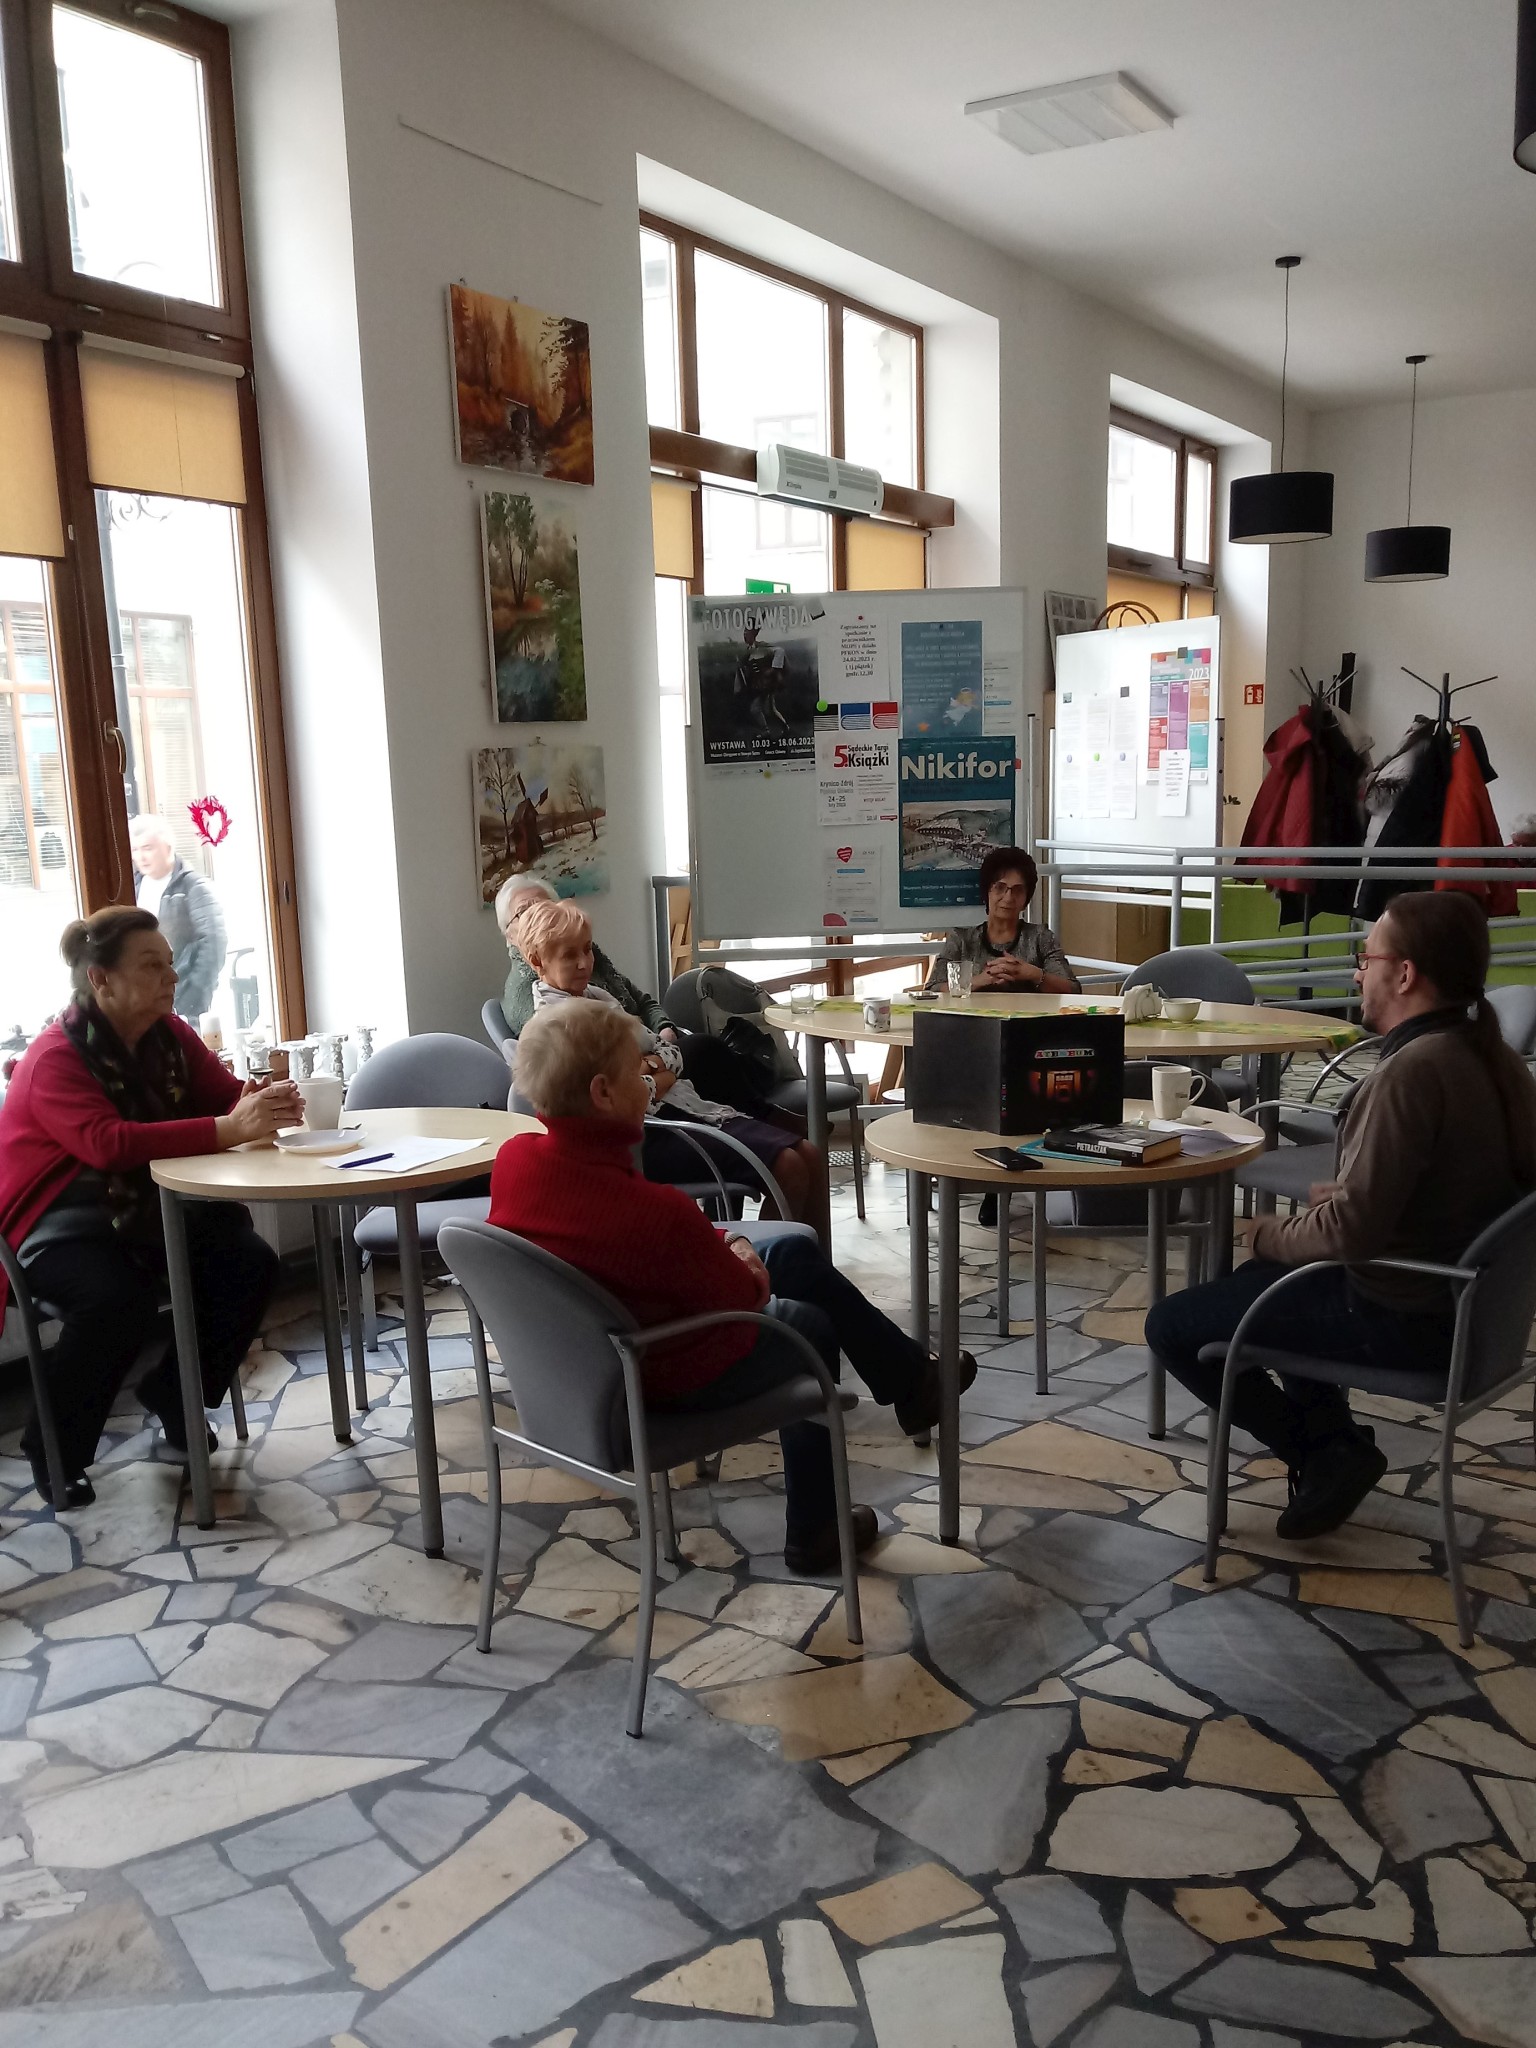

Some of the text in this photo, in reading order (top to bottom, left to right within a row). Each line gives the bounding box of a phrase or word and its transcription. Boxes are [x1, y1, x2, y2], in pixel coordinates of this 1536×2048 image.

[702, 604, 812, 634] FOTOGAWĘDA
[1189, 667, 1210, 679] 2023
[709, 740, 746, 750] WYSTAWA
[751, 739, 770, 748] 10.03
[778, 736, 815, 747] 18.06.2023
[834, 743, 889, 767] 5. Sądeckie Targi
[848, 752, 889, 770] Książki
[901, 751, 1012, 780] Nikifor
[1076, 1142, 1107, 1155] PIETRASZAK
